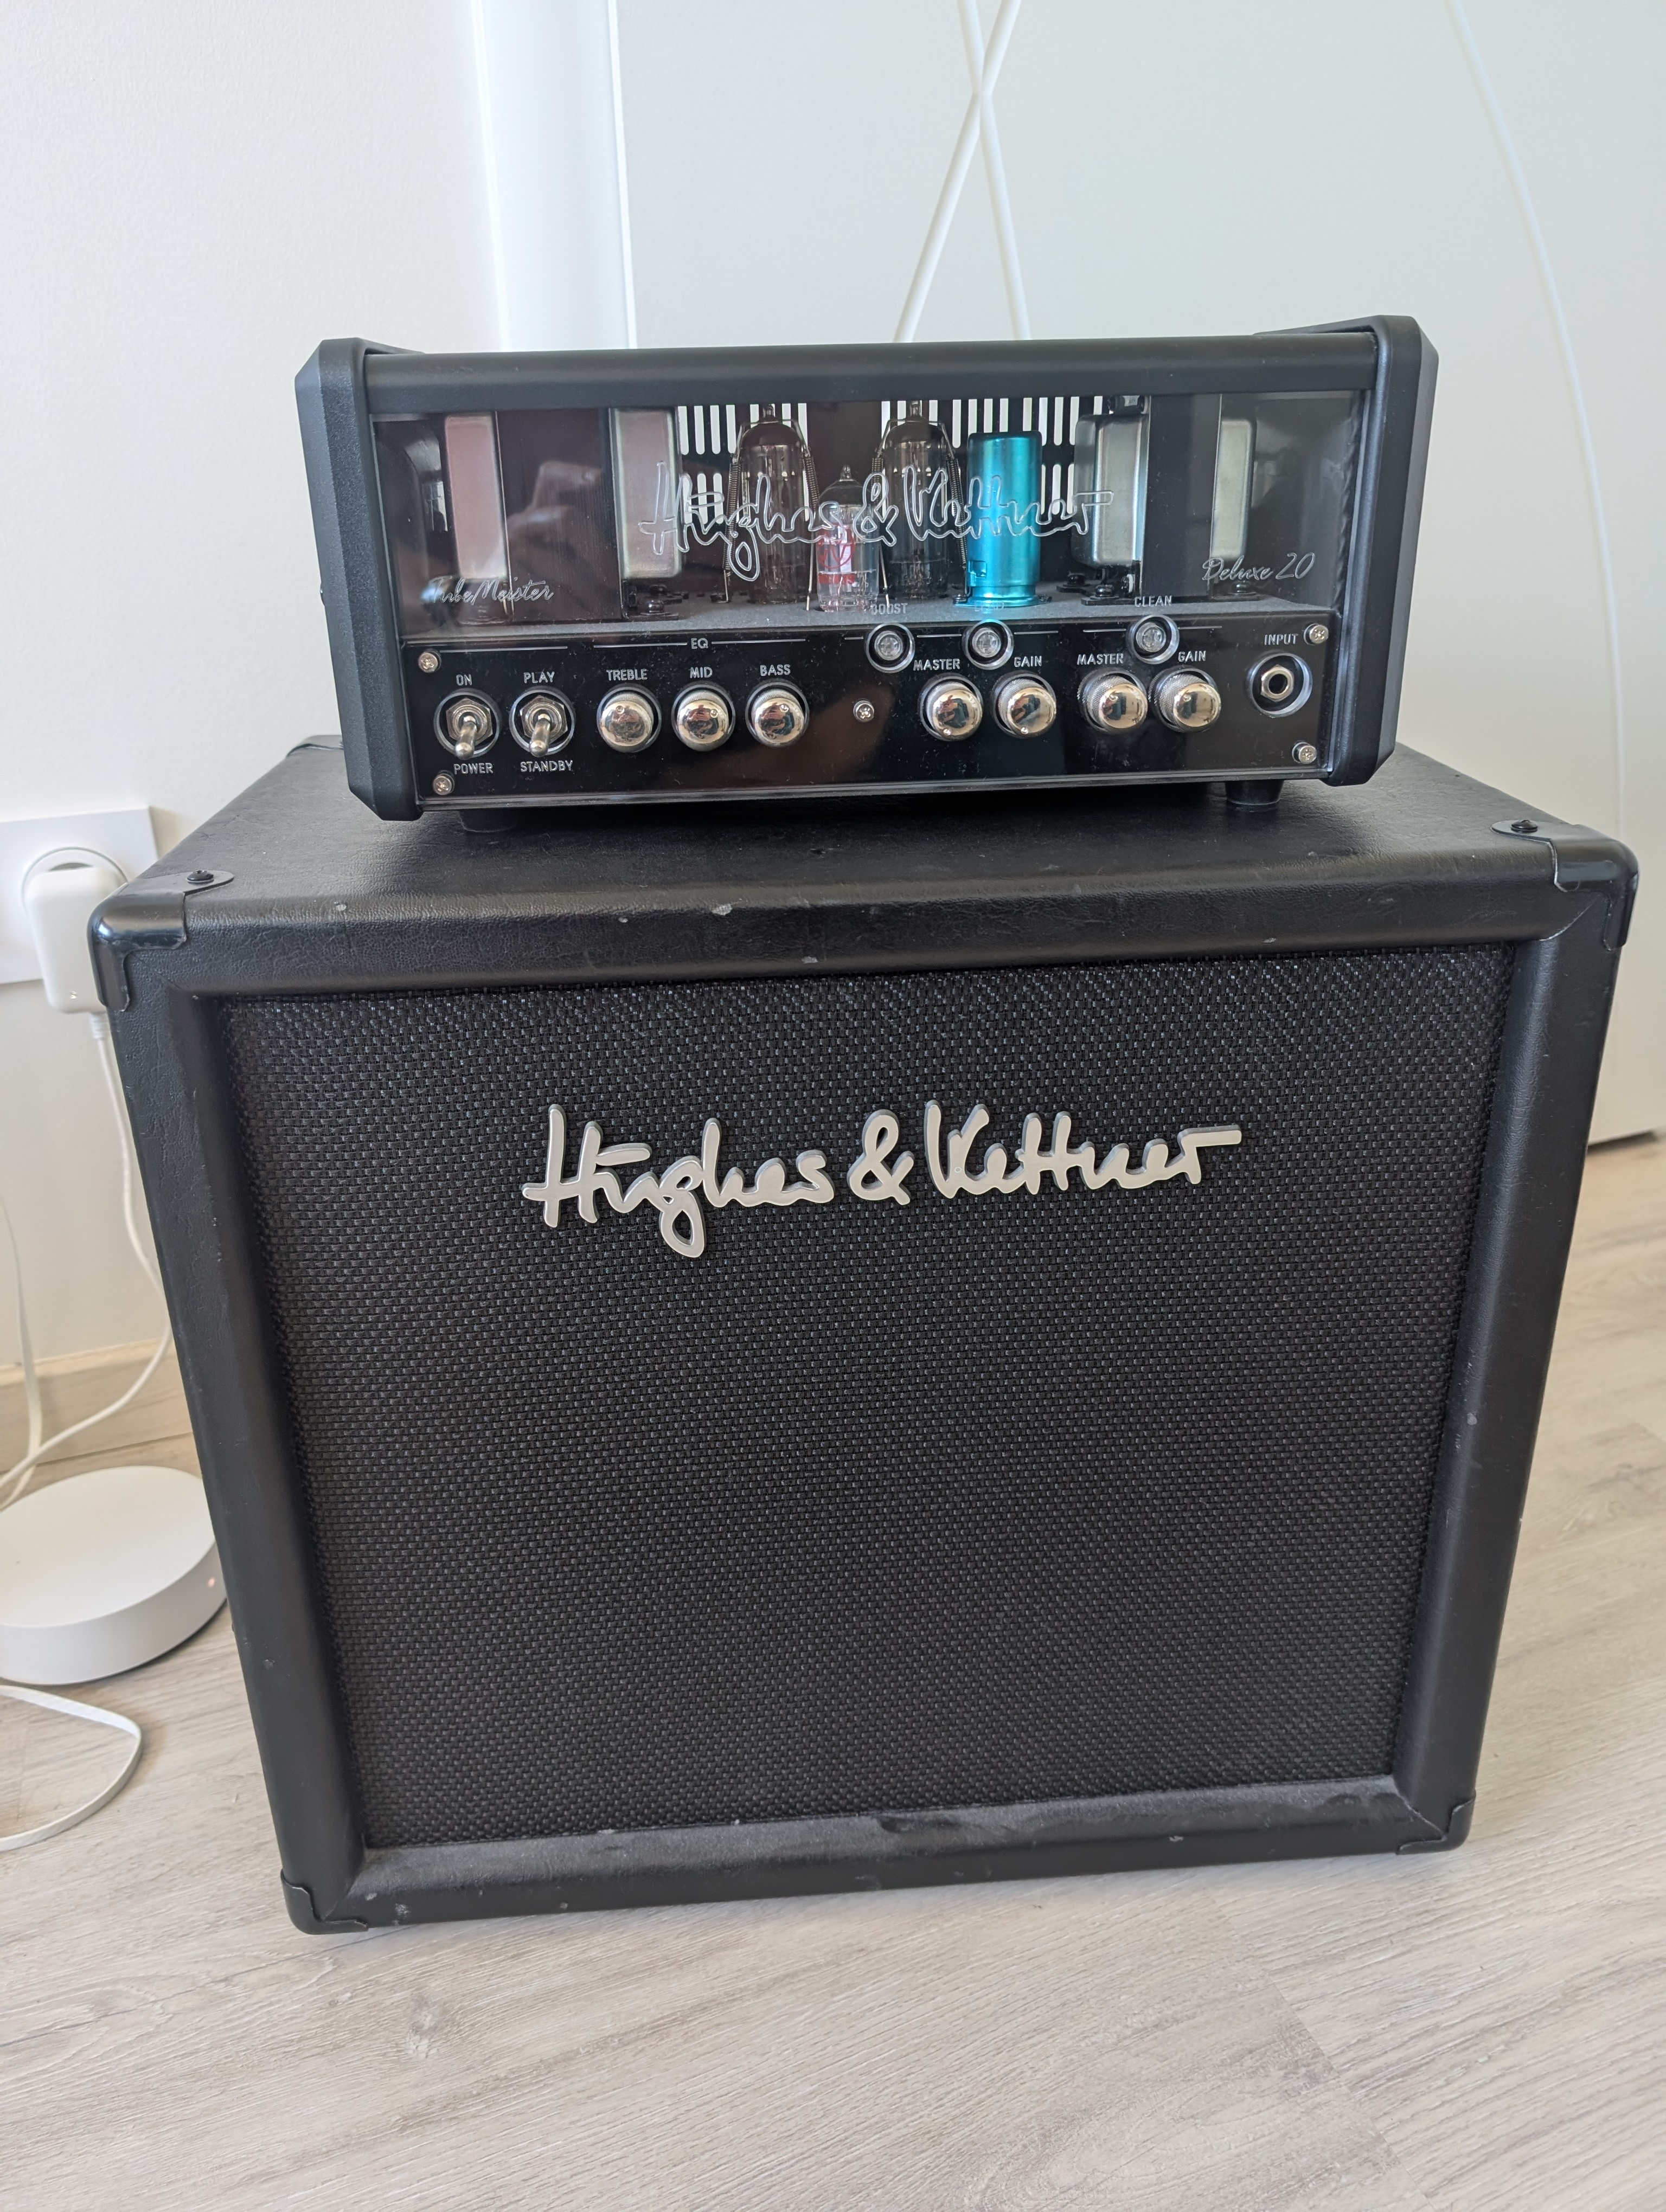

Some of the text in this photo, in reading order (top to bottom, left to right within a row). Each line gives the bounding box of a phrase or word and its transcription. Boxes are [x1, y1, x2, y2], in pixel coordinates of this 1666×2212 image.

[639, 461, 1114, 581] Hughes & Kettner
[1202, 552, 1316, 581] Deluxe 20
[1134, 595, 1172, 608] CLEAN
[871, 603, 908, 615] BOOST
[691, 638, 709, 650] EQ
[1264, 633, 1298, 646] INPUT
[1014, 655, 1042, 667] GAIN
[1077, 653, 1124, 666] MASTER
[1177, 651, 1207, 663] GAIN
[760, 664, 791, 677] BASS
[913, 658, 960, 671] MASTER
[523, 671, 555, 684] PLAY
[606, 668, 648, 681] TREBLE
[690, 666, 713, 679] MID
[456, 674, 472, 686] ON
[453, 762, 494, 775] POWER
[520, 760, 573, 773] STANDBY
[521, 1098, 1243, 1259] Hughes & Kettner
